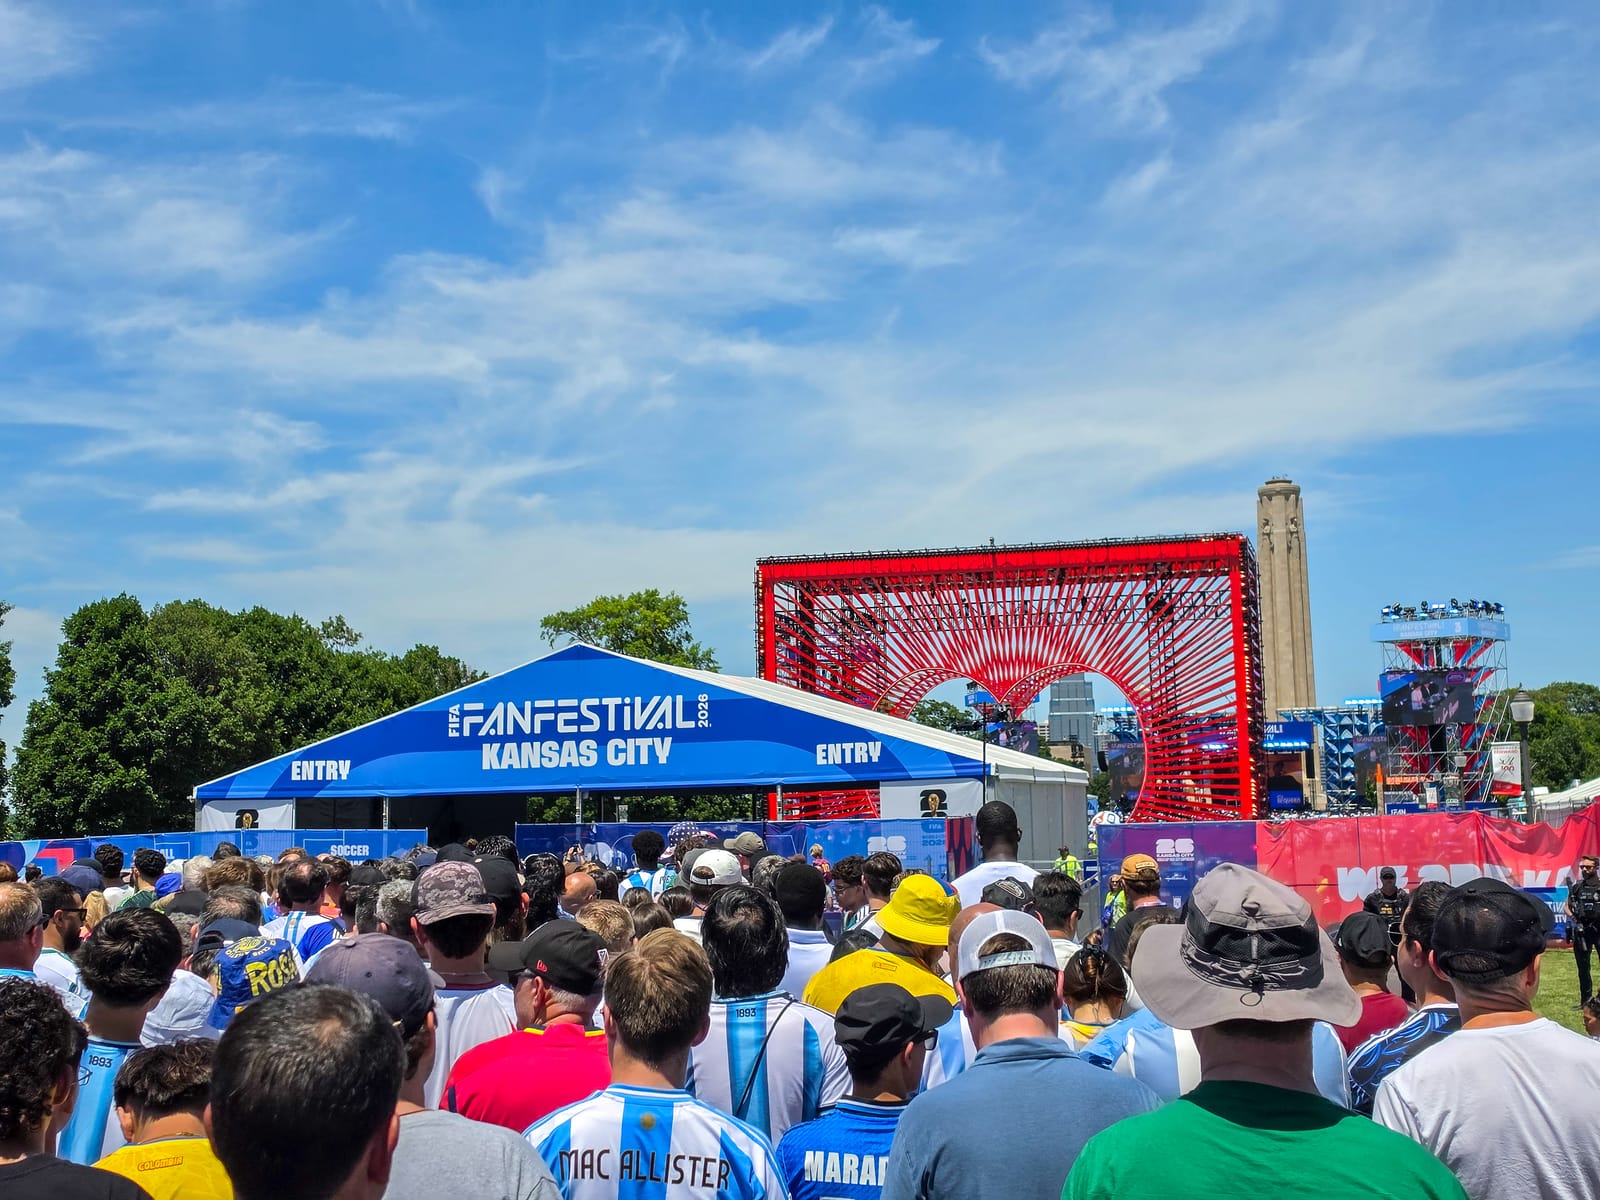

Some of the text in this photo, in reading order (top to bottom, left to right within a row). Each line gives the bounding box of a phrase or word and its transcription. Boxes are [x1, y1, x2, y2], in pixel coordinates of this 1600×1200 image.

[448, 704, 461, 737] FIFA
[698, 693, 712, 728] 2026
[482, 736, 673, 770] KANSAS CITY
[816, 741, 882, 766] ENTRY
[291, 760, 351, 781] ENTRY
[330, 845, 369, 856] SOCCER
[1155, 838, 1195, 854] 26
[736, 1008, 757, 1018] 1893
[88, 1055, 113, 1068] 1893
[138, 1156, 184, 1171] COLOMBIA
[559, 1149, 732, 1190] MAC ALLISTER
